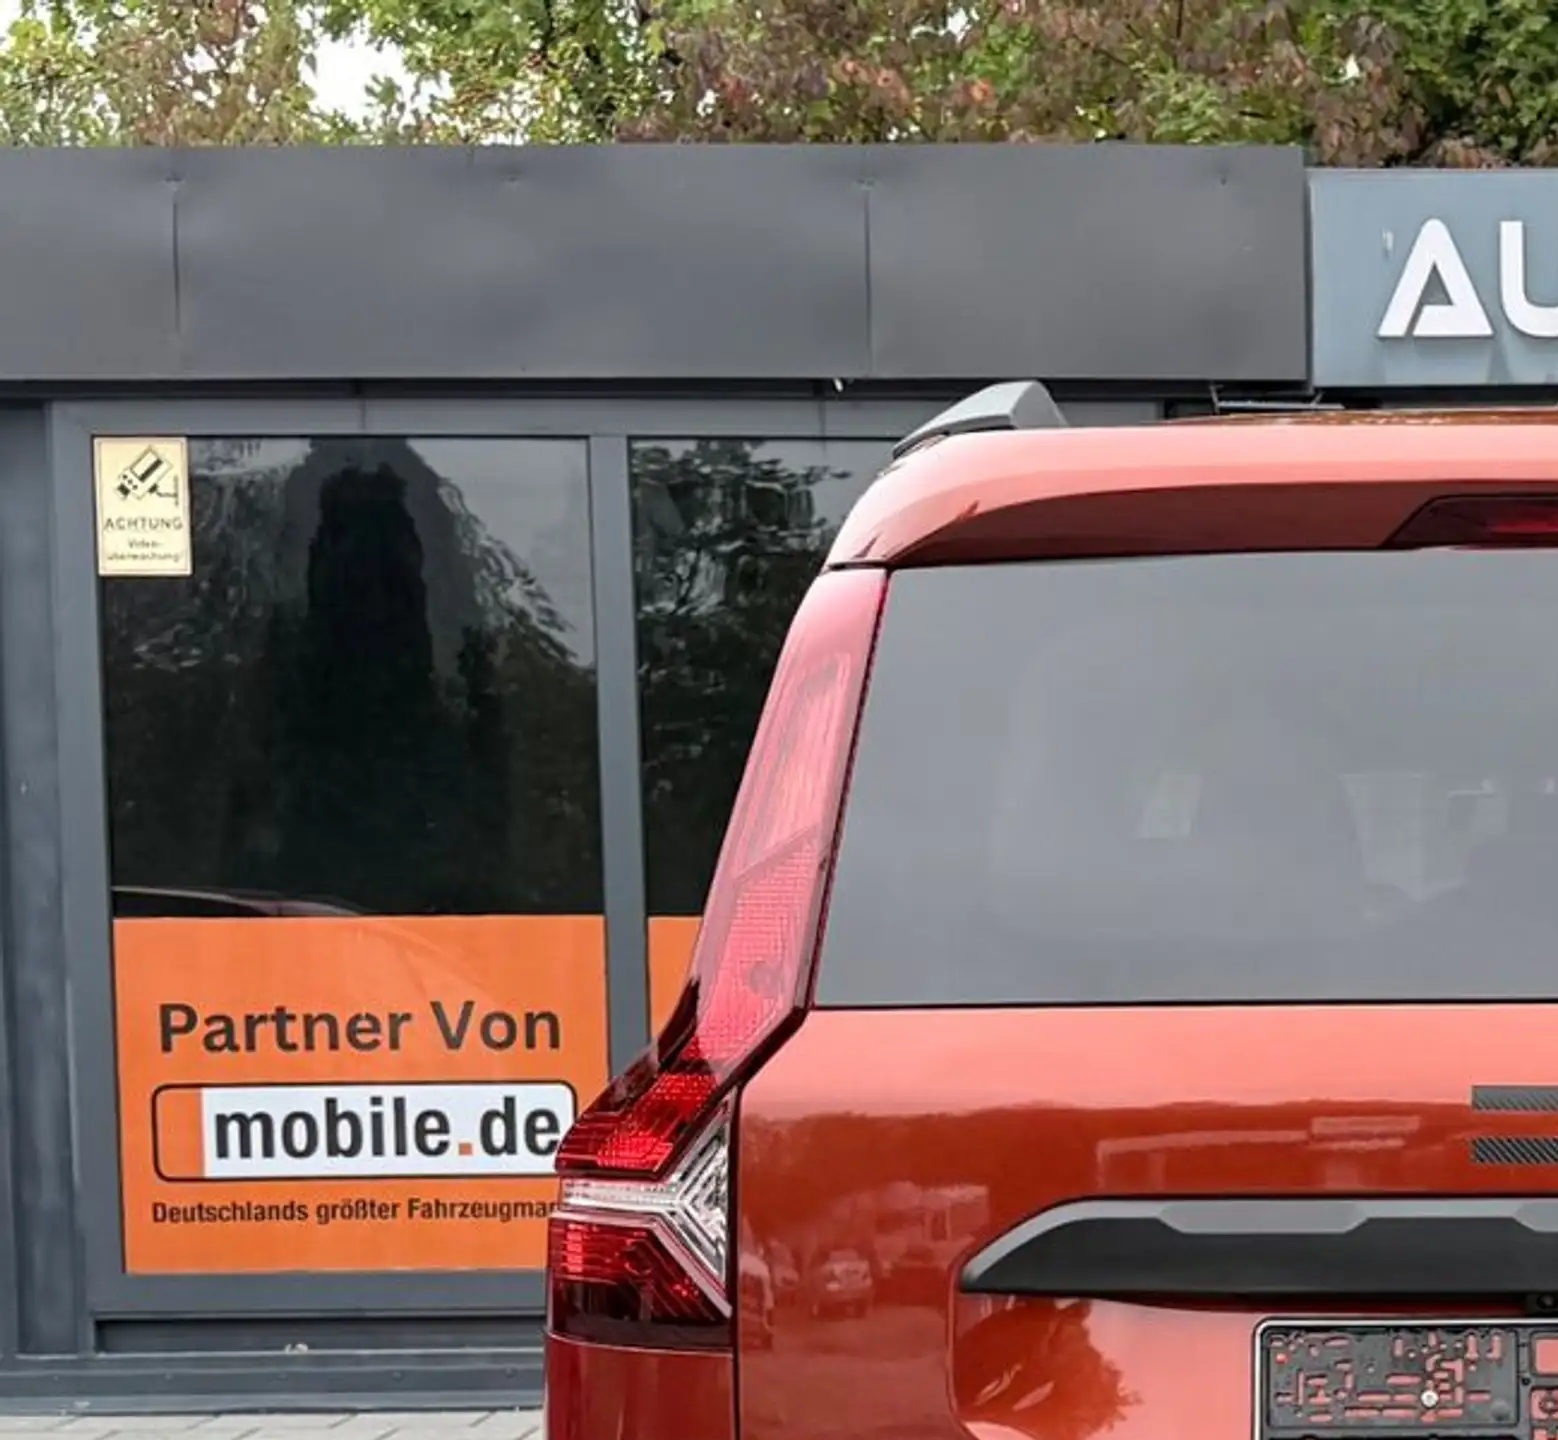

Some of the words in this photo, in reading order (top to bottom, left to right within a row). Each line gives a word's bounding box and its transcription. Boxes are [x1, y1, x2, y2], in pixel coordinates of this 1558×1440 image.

[104, 515, 183, 531] ACHTUNG
[159, 1002, 413, 1053] Partner
[430, 1000, 561, 1051] Von
[214, 1096, 560, 1160] mobile.de
[152, 1201, 309, 1224] Deutschlands
[316, 1198, 400, 1225] größter
